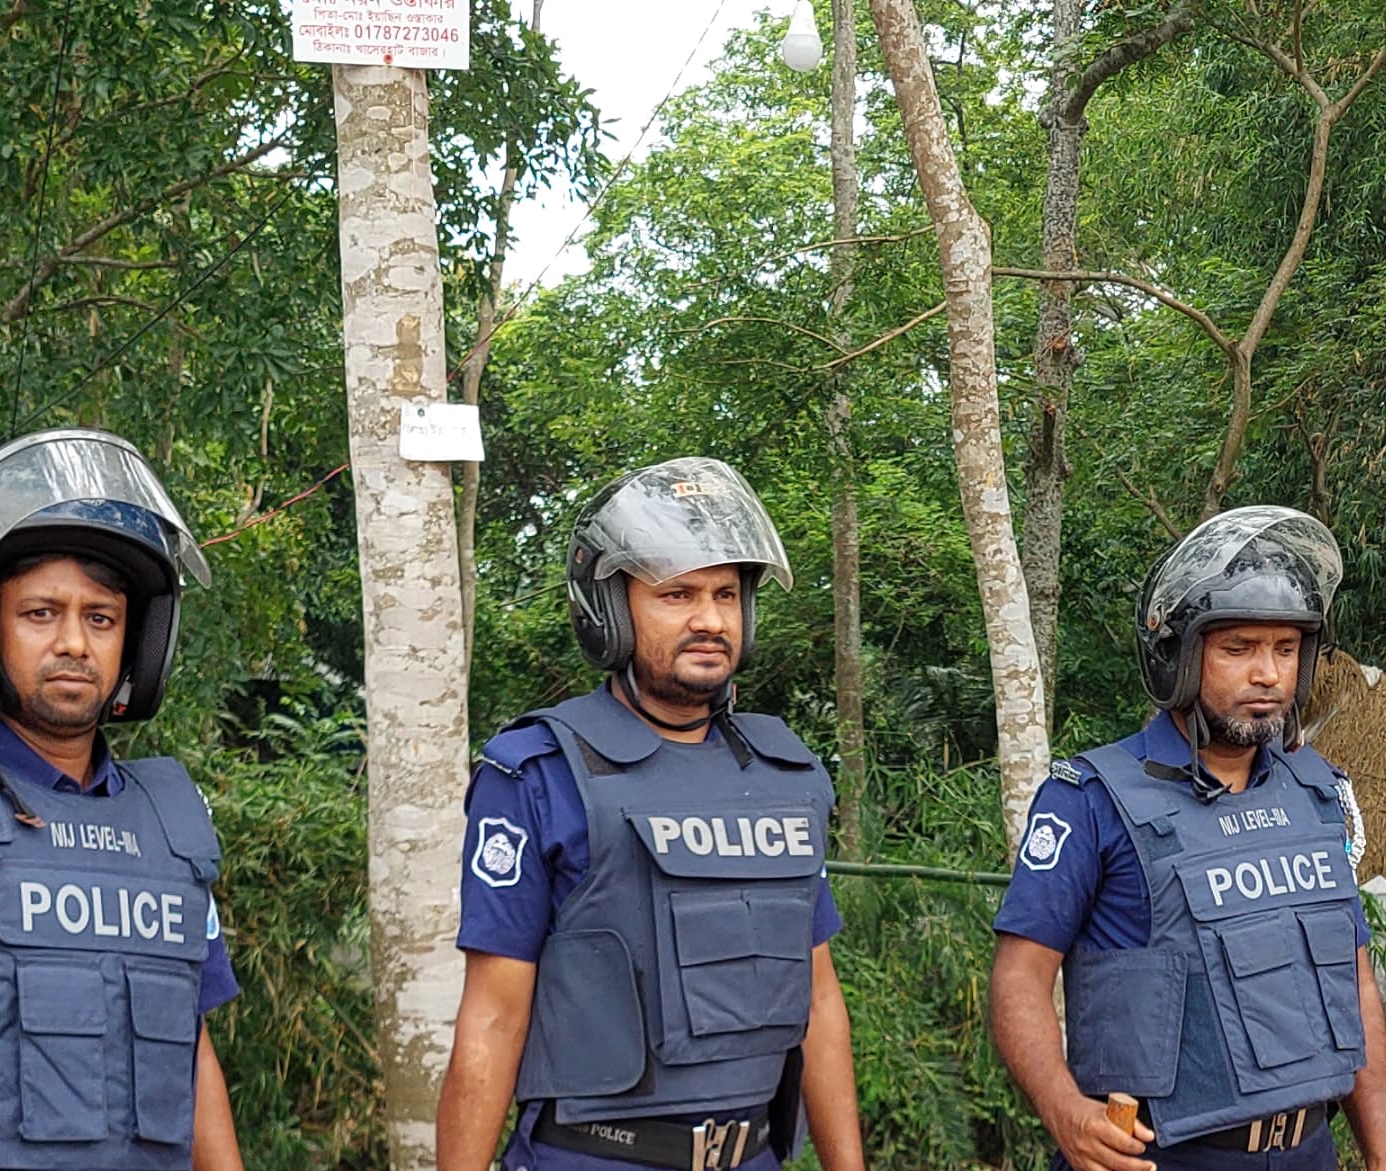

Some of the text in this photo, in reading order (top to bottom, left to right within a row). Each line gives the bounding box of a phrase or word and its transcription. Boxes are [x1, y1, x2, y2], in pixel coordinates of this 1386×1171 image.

[354, 23, 459, 42] 01787273046
[647, 816, 815, 857] POLICE
[1205, 851, 1338, 907] POLICE
[20, 881, 185, 944] POLICE
[590, 1123, 636, 1145] POLICE
